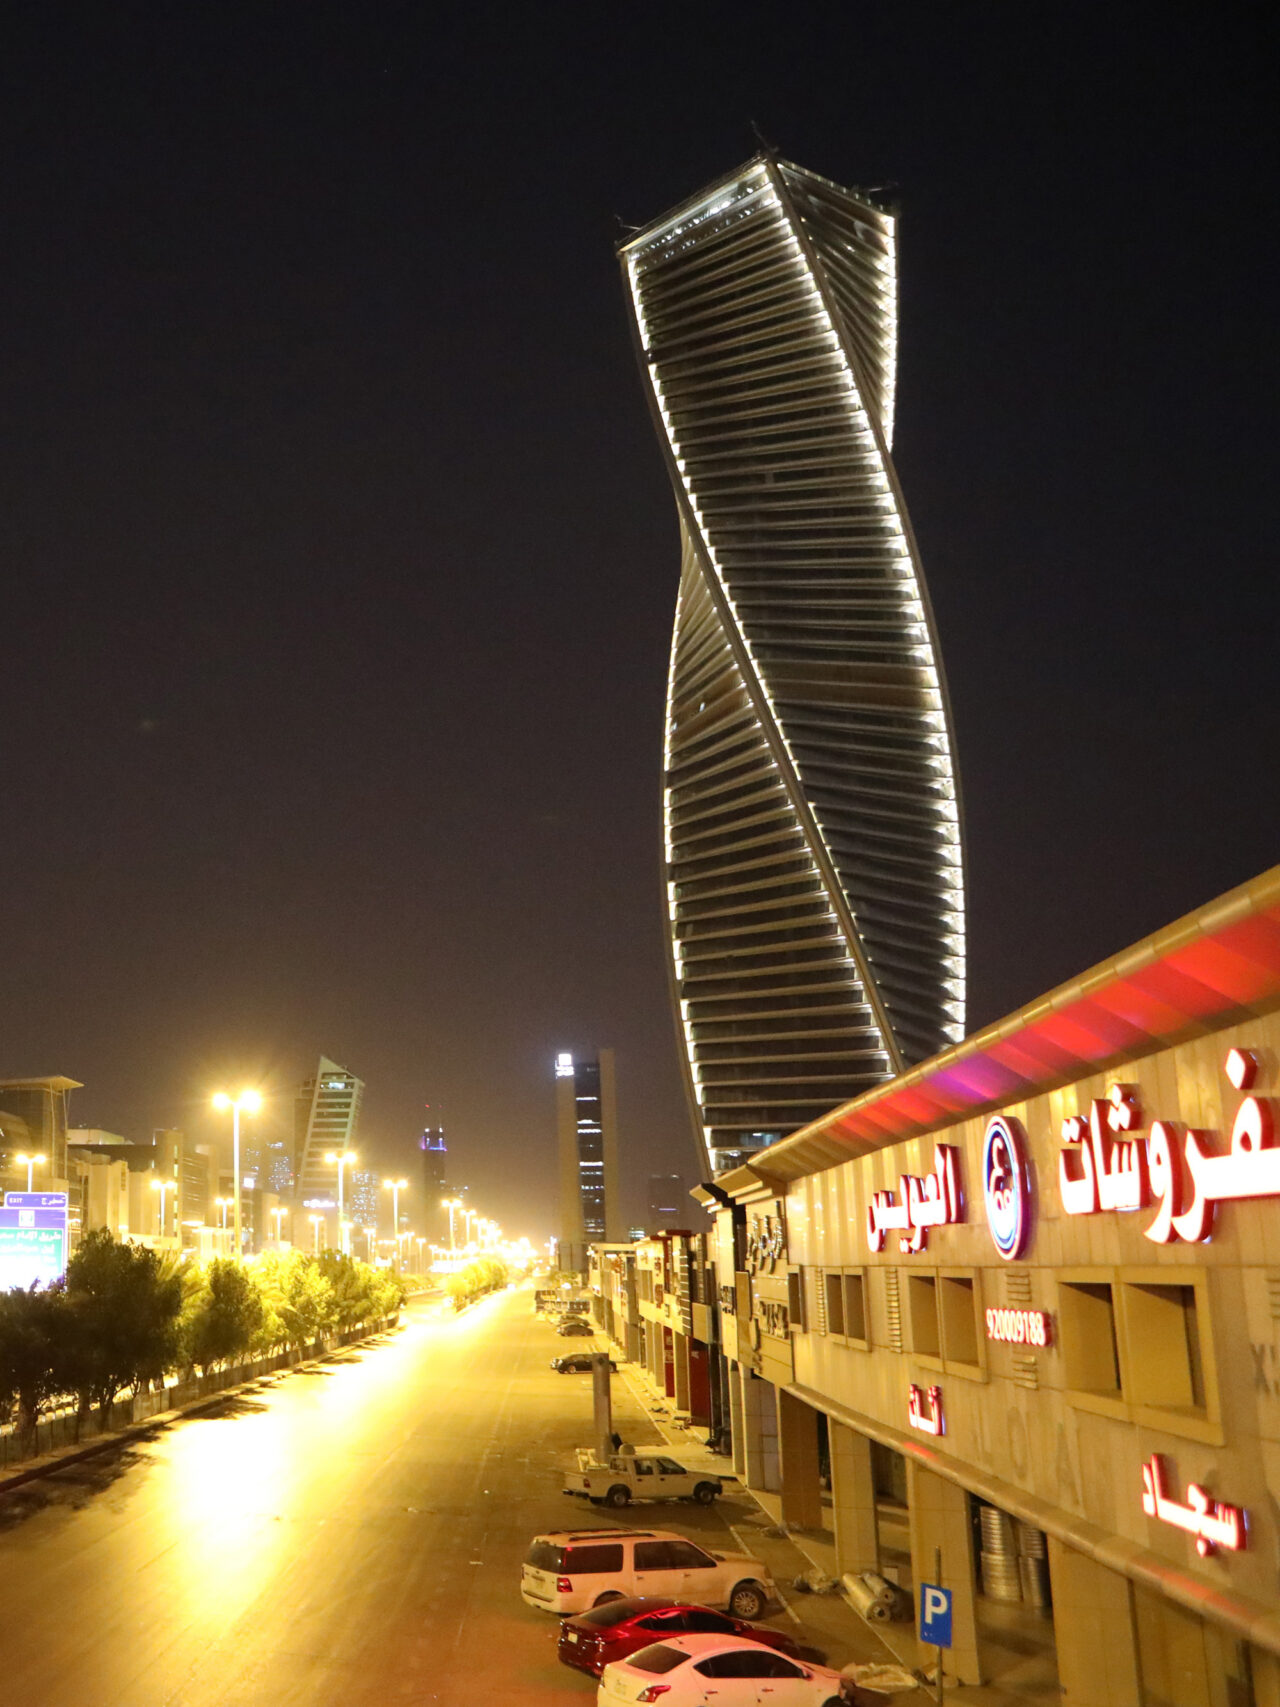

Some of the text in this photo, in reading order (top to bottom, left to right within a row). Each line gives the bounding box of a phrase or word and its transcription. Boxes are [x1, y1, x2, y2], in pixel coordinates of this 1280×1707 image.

[1060, 1048, 1280, 1243] فروشات
[985, 1307, 1048, 1347] 920009188
[1141, 1453, 1241, 1558] سجاد
[924, 1587, 948, 1625] P
